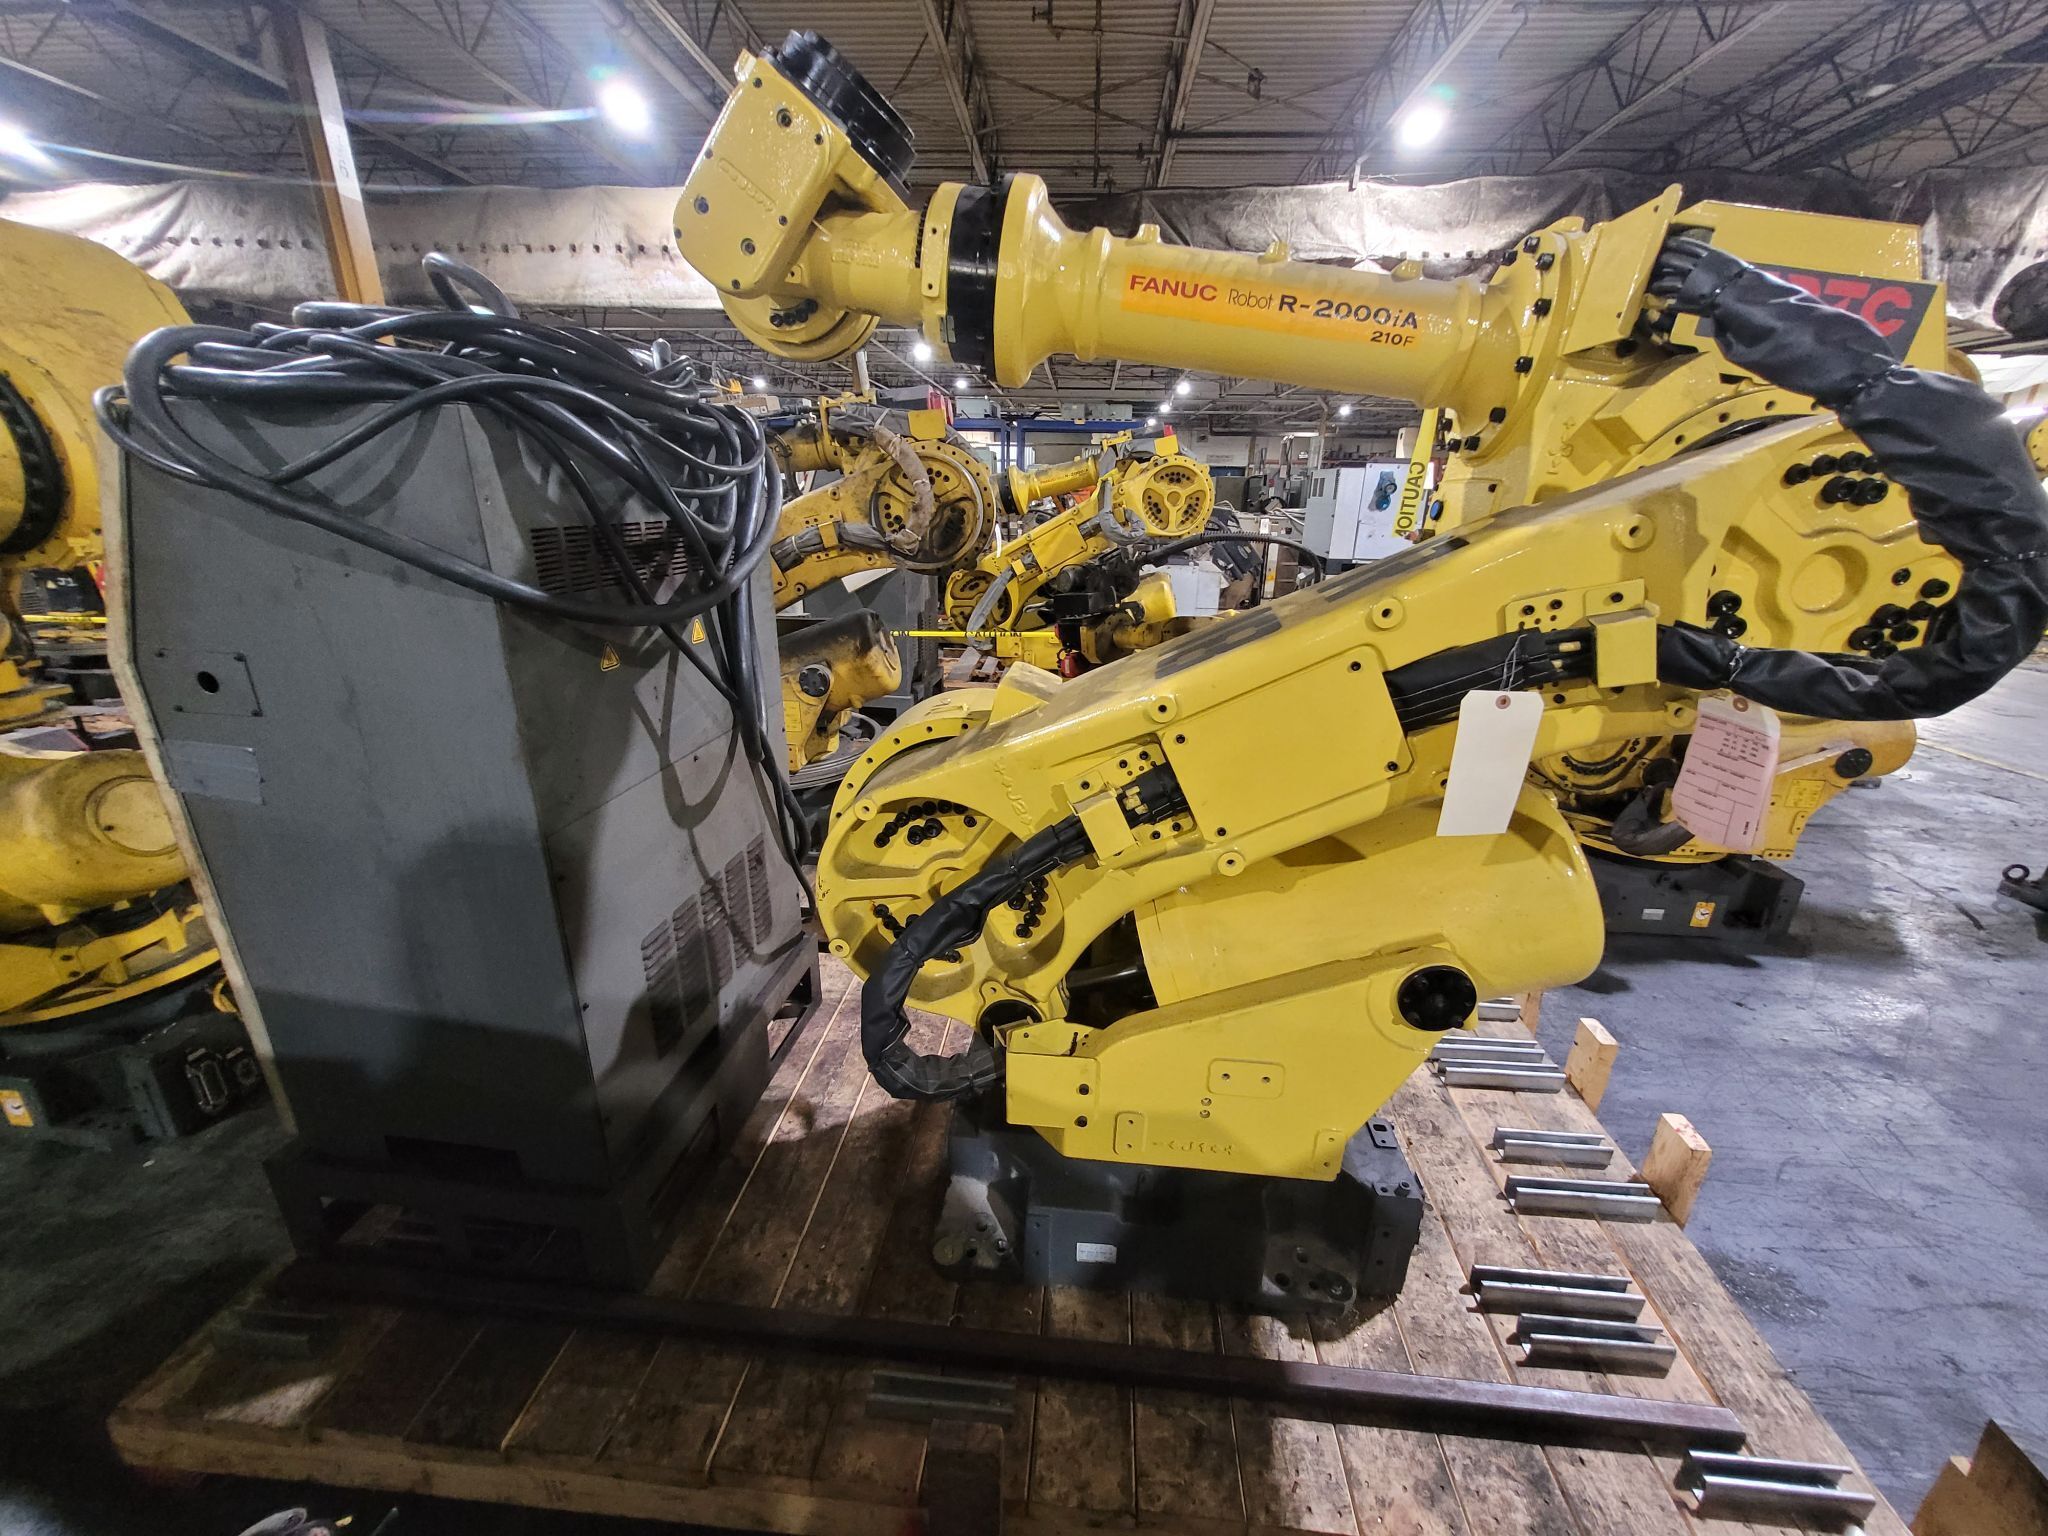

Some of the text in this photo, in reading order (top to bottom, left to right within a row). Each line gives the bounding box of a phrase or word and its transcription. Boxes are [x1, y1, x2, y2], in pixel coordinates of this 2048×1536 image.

[1130, 275, 1418, 329] FANUC Robot R-2000iA
[1370, 330, 1416, 347] 210F
